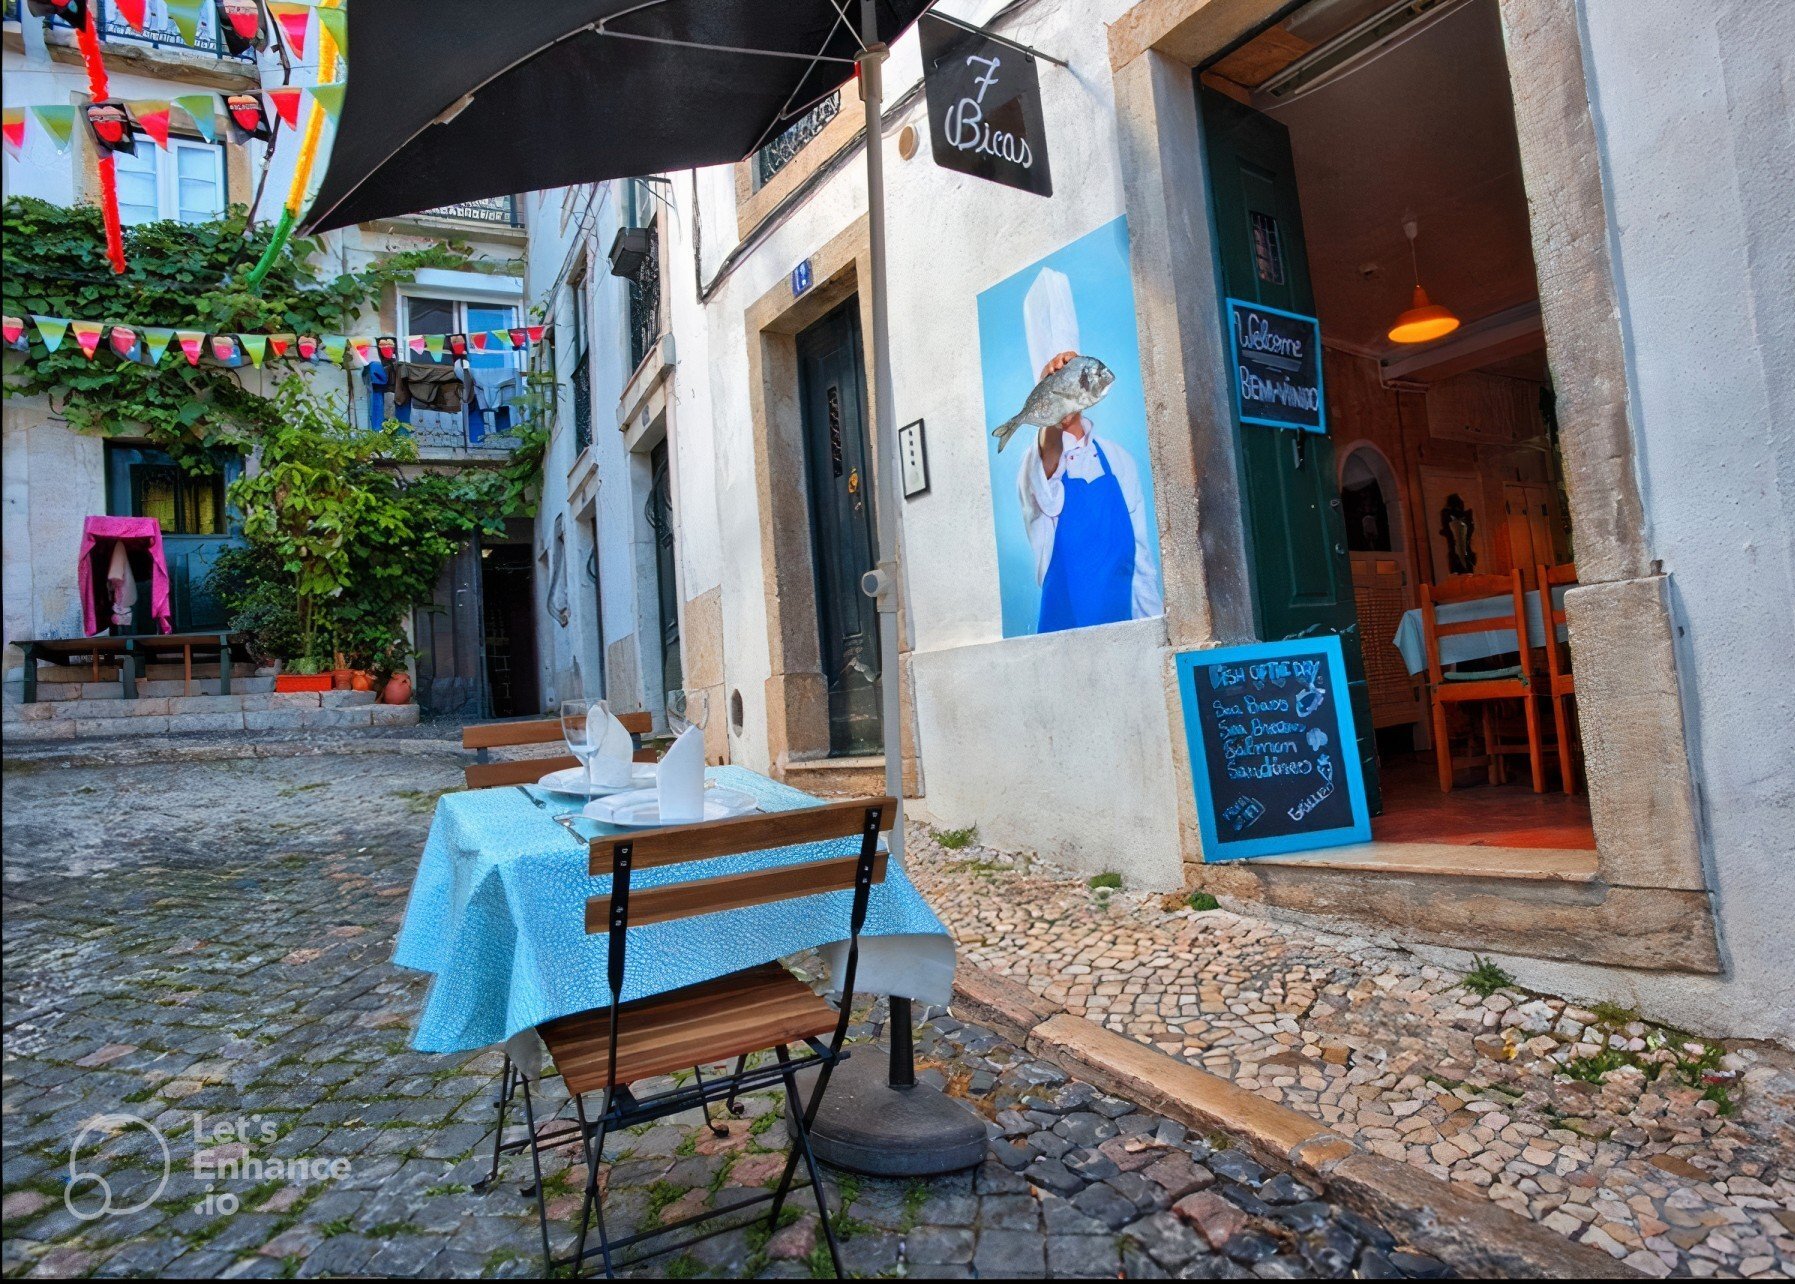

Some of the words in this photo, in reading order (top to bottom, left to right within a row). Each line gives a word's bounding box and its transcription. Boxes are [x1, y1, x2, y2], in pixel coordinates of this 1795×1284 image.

[966, 55, 1001, 104] 7
[944, 97, 1034, 169] Bicas
[1233, 311, 1303, 358] Welcome
